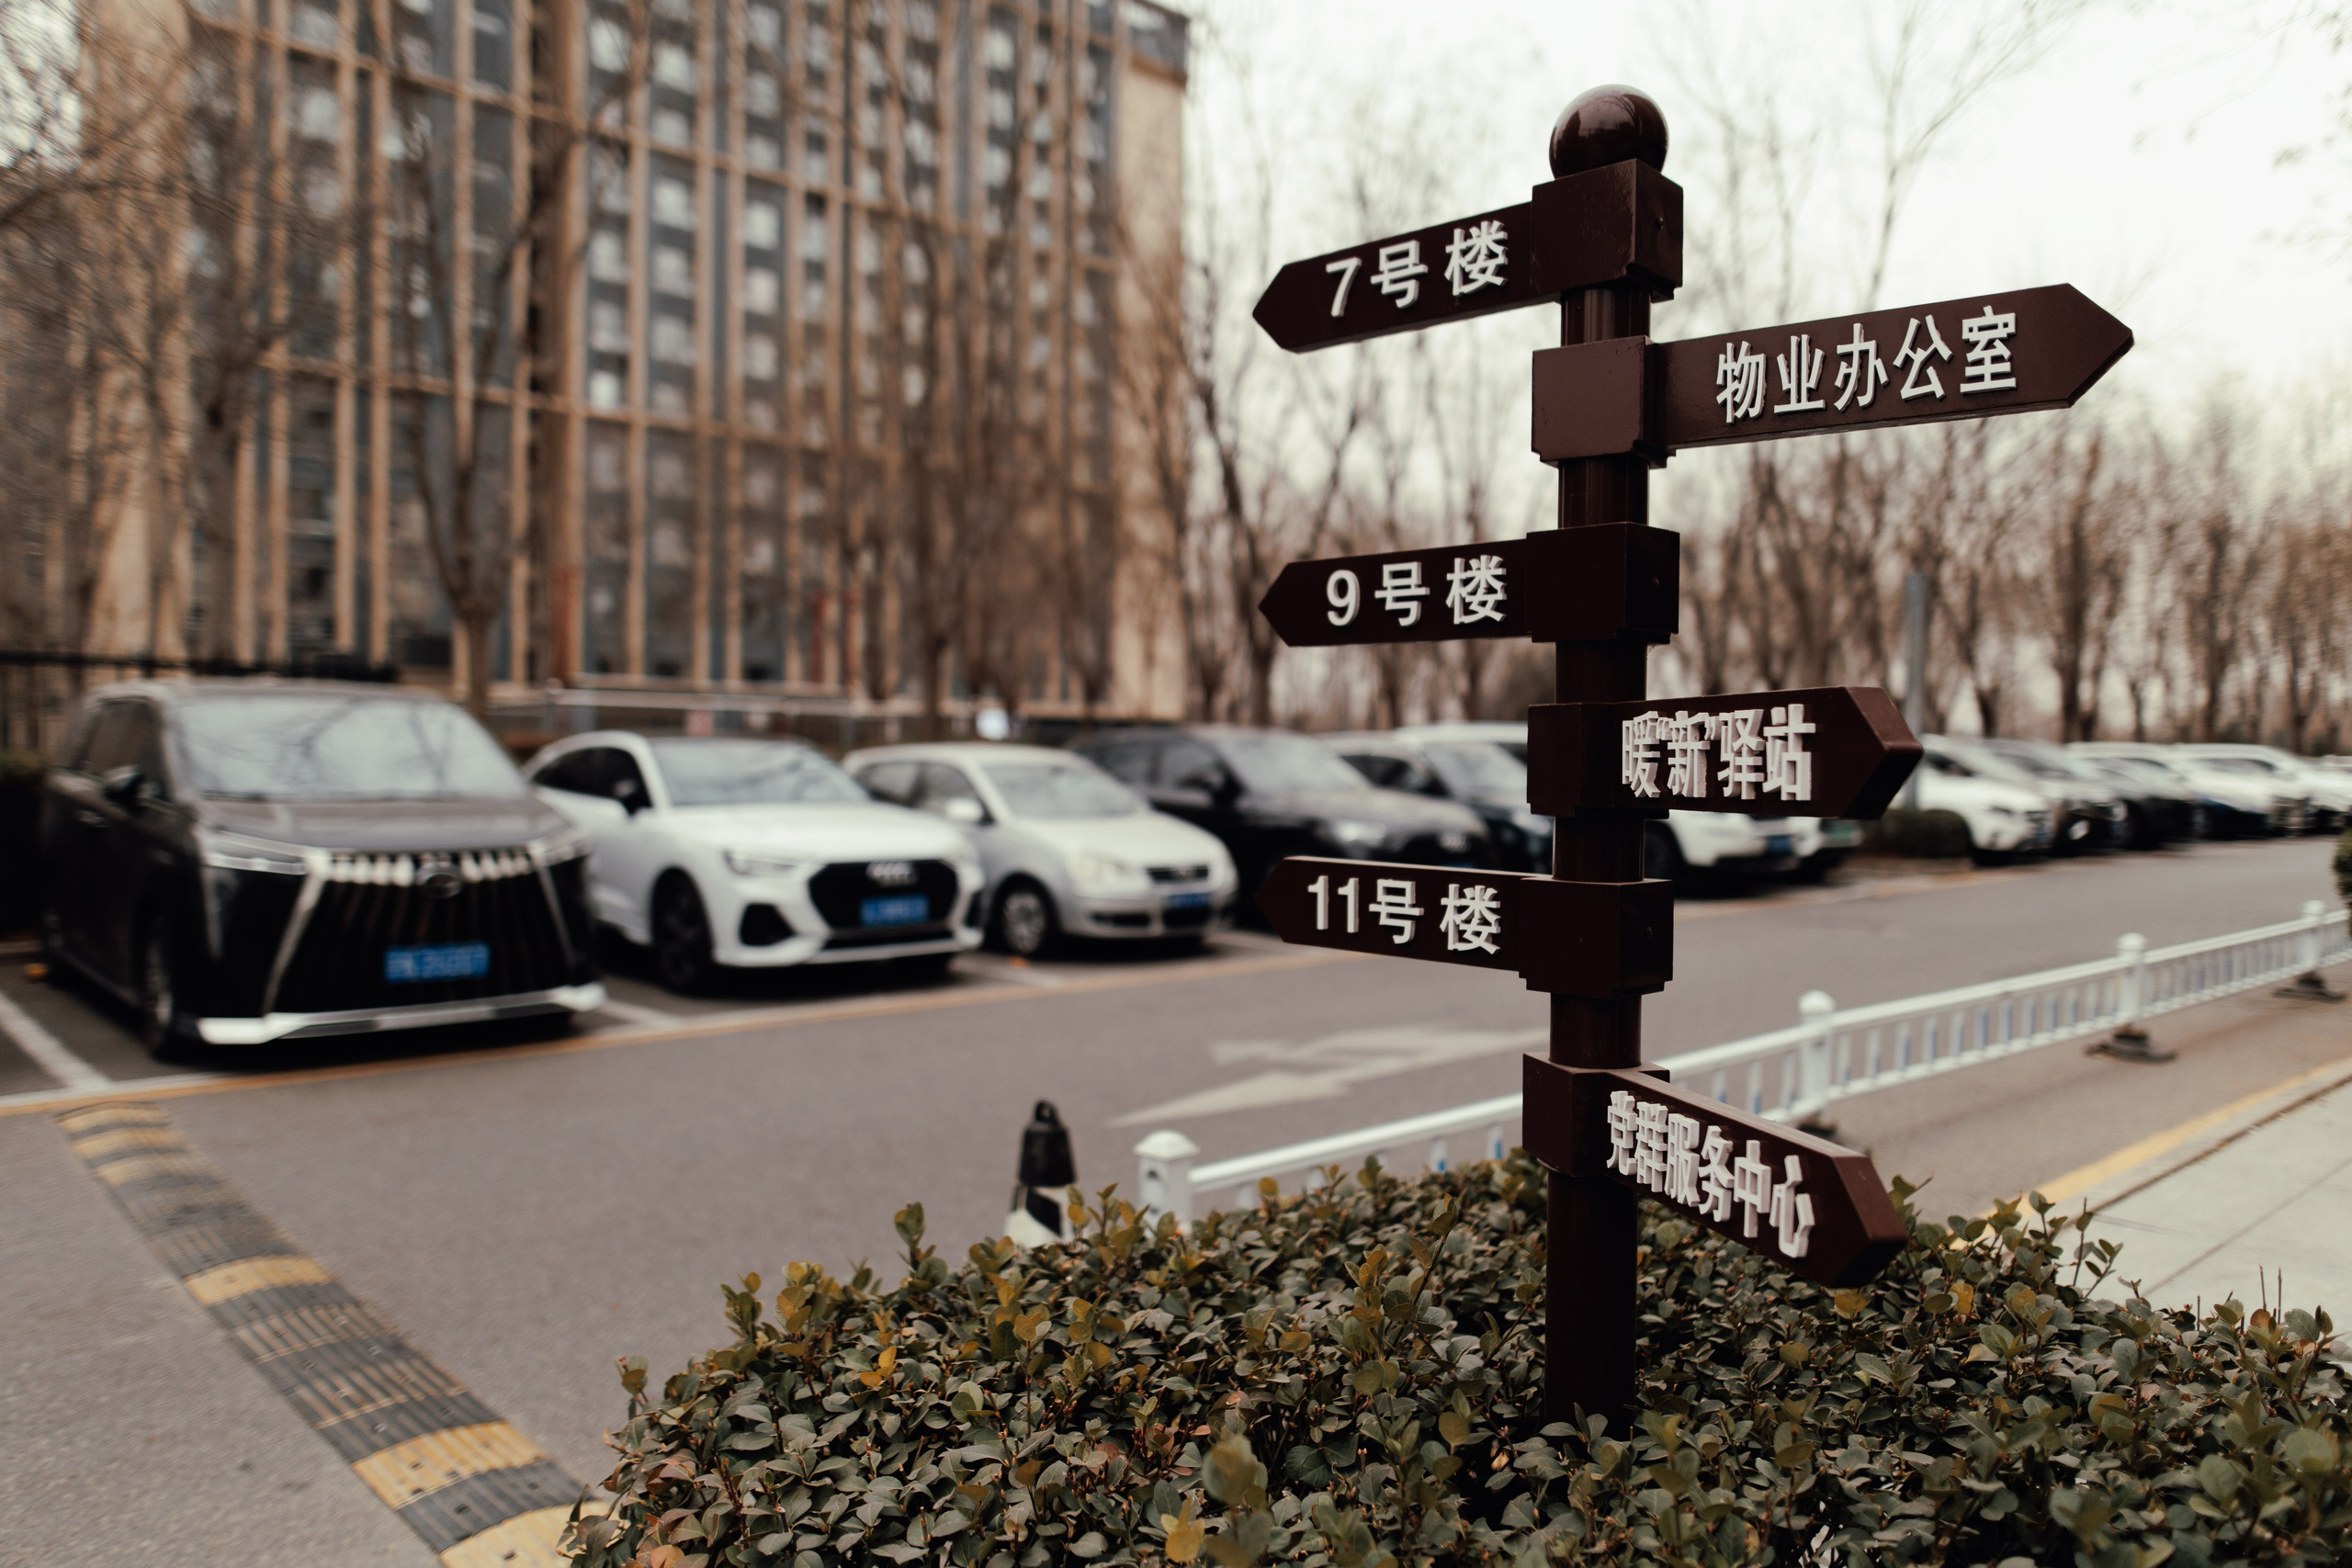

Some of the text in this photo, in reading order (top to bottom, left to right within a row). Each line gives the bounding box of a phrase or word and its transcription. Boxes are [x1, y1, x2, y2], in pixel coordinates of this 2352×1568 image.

[1325, 220, 1509, 317] 7号楼
[1715, 305, 2018, 424] 物业办公室
[1326, 554, 1508, 626] 9号楼
[1307, 875, 1501, 955] 11号楼
[1606, 1090, 1815, 1258] 党群服务中心
